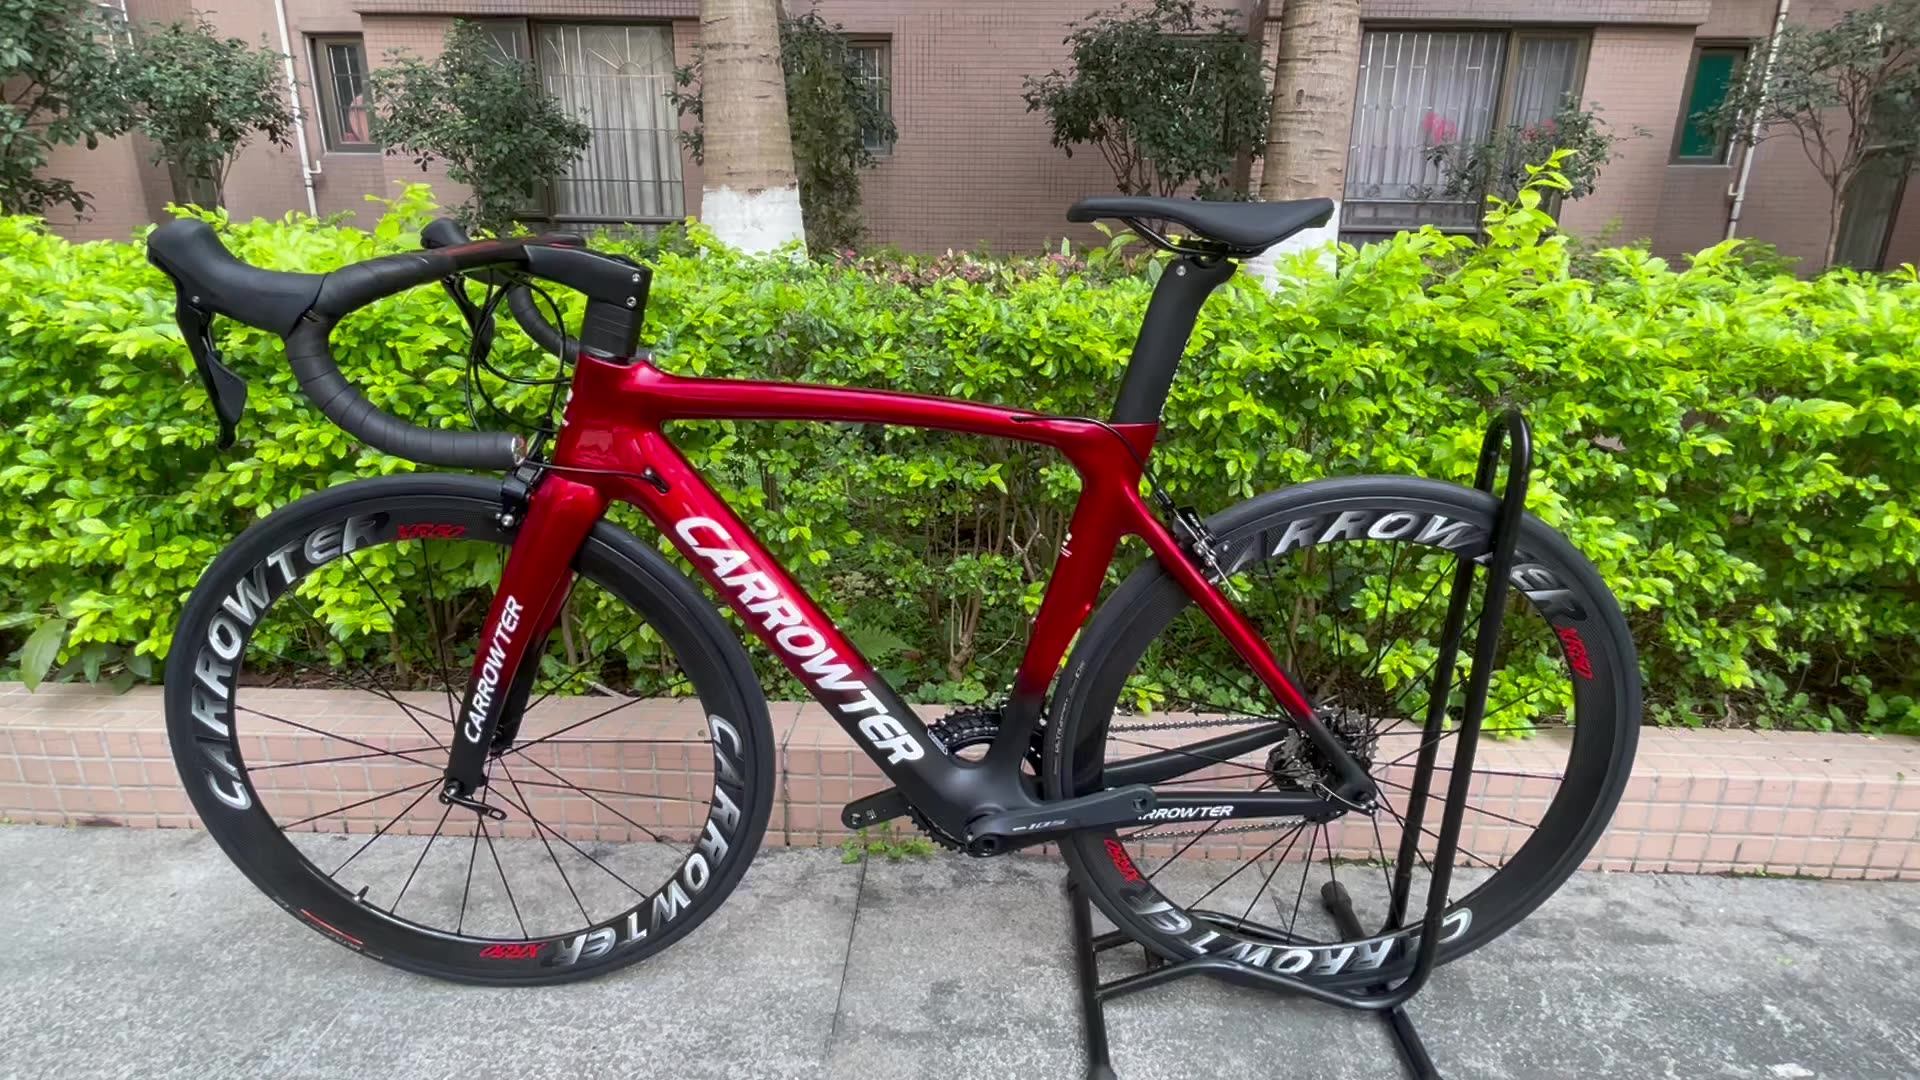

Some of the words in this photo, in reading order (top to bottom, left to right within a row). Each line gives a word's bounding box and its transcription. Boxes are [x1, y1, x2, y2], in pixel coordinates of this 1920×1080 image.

[192, 511, 391, 810] CARROWTER
[464, 594, 524, 743] CARROWTER
[675, 516, 925, 765] CARROWTER
[542, 714, 745, 966] CARROWTER
